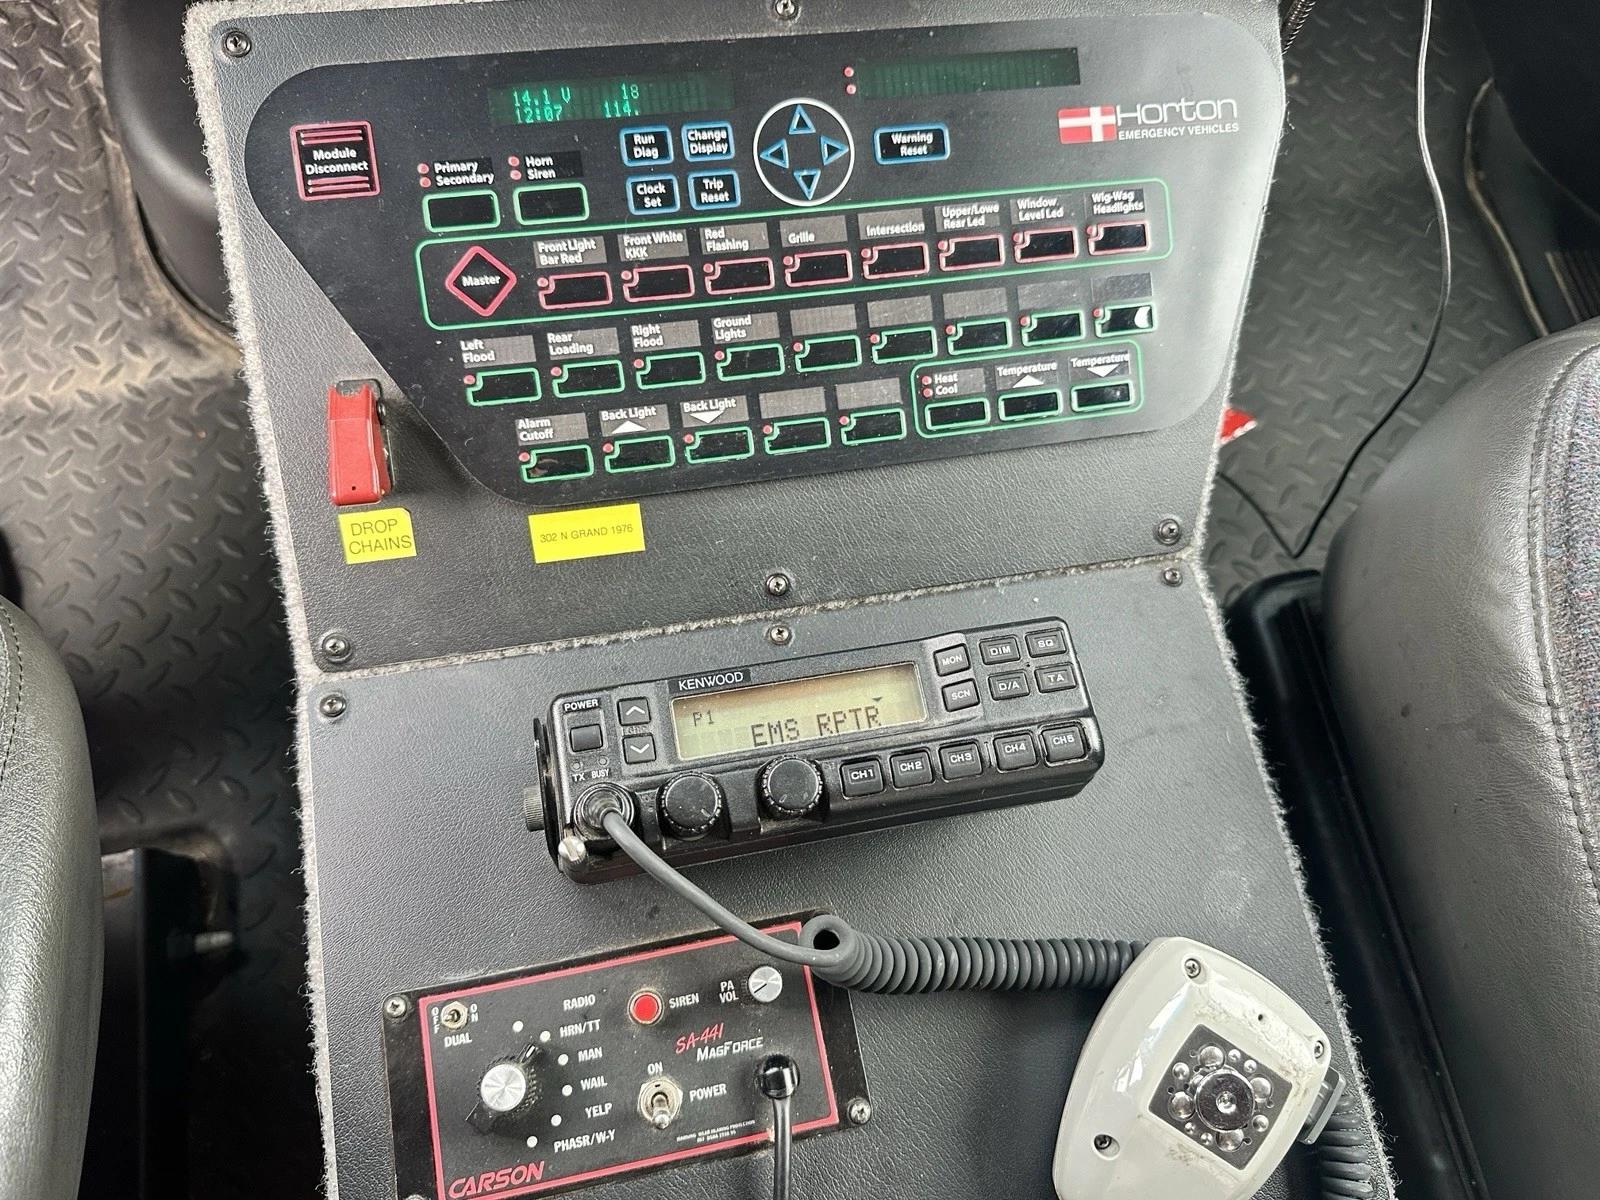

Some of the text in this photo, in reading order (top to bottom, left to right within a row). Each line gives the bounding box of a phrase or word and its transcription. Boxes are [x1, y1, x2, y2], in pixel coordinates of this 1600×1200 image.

[513, 83, 639, 107] 14.1 V 18
[516, 105, 562, 123] 12:07
[1117, 97, 1237, 126] Horton
[688, 130, 727, 143] Change
[1119, 123, 1240, 140] EMERGENCY VEHICLES
[634, 134, 655, 145] Run
[892, 132, 933, 145] Warning
[313, 148, 356, 160] Module
[634, 147, 658, 159] Diag
[690, 142, 728, 156] Display
[900, 144, 928, 156] Reset
[306, 160, 368, 175] Disconnect
[434, 161, 478, 175] Primary
[525, 155, 553, 168] Horn
[436, 172, 494, 187] Secondary
[527, 168, 556, 179] Siren
[637, 183, 666, 195] Clock
[703, 179, 723, 191] Trip
[644, 196, 662, 208] Set
[701, 191, 729, 203] Reset
[1017, 197, 1057, 210] Window
[1092, 190, 1134, 204] Wig-Wag
[1094, 200, 1144, 214] Headlights
[1019, 207, 1063, 221] Level Led
[867, 221, 925, 237] Intersection
[944, 216, 985, 229] Rear Led
[624, 231, 683, 246] Front White
[705, 228, 724, 240] Red
[788, 232, 815, 243] Grille
[538, 238, 596, 253] Front Light
[706, 238, 749, 252] Flashing
[540, 252, 582, 265] Bar Red
[625, 247, 648, 258] KKK
[462, 275, 500, 286] Master
[713, 315, 751, 328] Ground
[632, 324, 660, 337] Right
[715, 327, 746, 340] Lights
[548, 332, 572, 343] Rear
[633, 335, 663, 348] Flood
[461, 339, 484, 351] Left
[549, 342, 593, 355] Loading
[462, 351, 495, 362] Flood
[1071, 352, 1129, 368] Temperature
[997, 360, 1058, 377] Temperature
[935, 372, 958, 383] Heat
[936, 383, 958, 395] Cool
[683, 397, 736, 412] Back Light
[601, 406, 656, 420] Back Light
[518, 418, 550, 429] Alarm
[520, 428, 554, 442] Cutoff
[351, 518, 398, 536] DROP
[540, 524, 633, 543] 302 N GRAND 1976
[349, 535, 412, 555] CHAINS
[1038, 639, 1054, 648] SQ
[990, 645, 1010, 656] DIM
[943, 654, 962, 665] MON
[679, 671, 744, 691] KENWOOD
[1048, 674, 1064, 683] TA
[999, 681, 1019, 691] D/A
[952, 690, 970, 700] SCN
[564, 699, 598, 711] POWER
[693, 711, 714, 726] P1
[752, 706, 880, 747] EMS RPTR
[1053, 735, 1074, 745] CH5
[1005, 743, 1026, 753] CH4
[950, 752, 972, 764] CH3
[900, 760, 922, 771] CH2
[572, 773, 585, 782] TX
[592, 769, 609, 778] BUSY
[851, 769, 874, 780] CH1
[720, 982, 734, 991] PA
[564, 994, 596, 1011] RADIO
[669, 993, 699, 1009] SIREN
[720, 990, 739, 1003] VOL
[470, 1003, 478, 1022] ON
[560, 1019, 601, 1038] HRN/TT
[444, 1033, 472, 1047] DUAL
[676, 1022, 724, 1054] SA-441
[578, 1047, 603, 1061] MAN
[647, 1062, 663, 1074] ON
[580, 1076, 608, 1090] WAIL
[689, 1083, 727, 1102] POWER
[585, 1103, 612, 1119] YELP
[554, 1129, 616, 1153] PHASR/W-Y
[448, 1161, 544, 1199] CARSON
